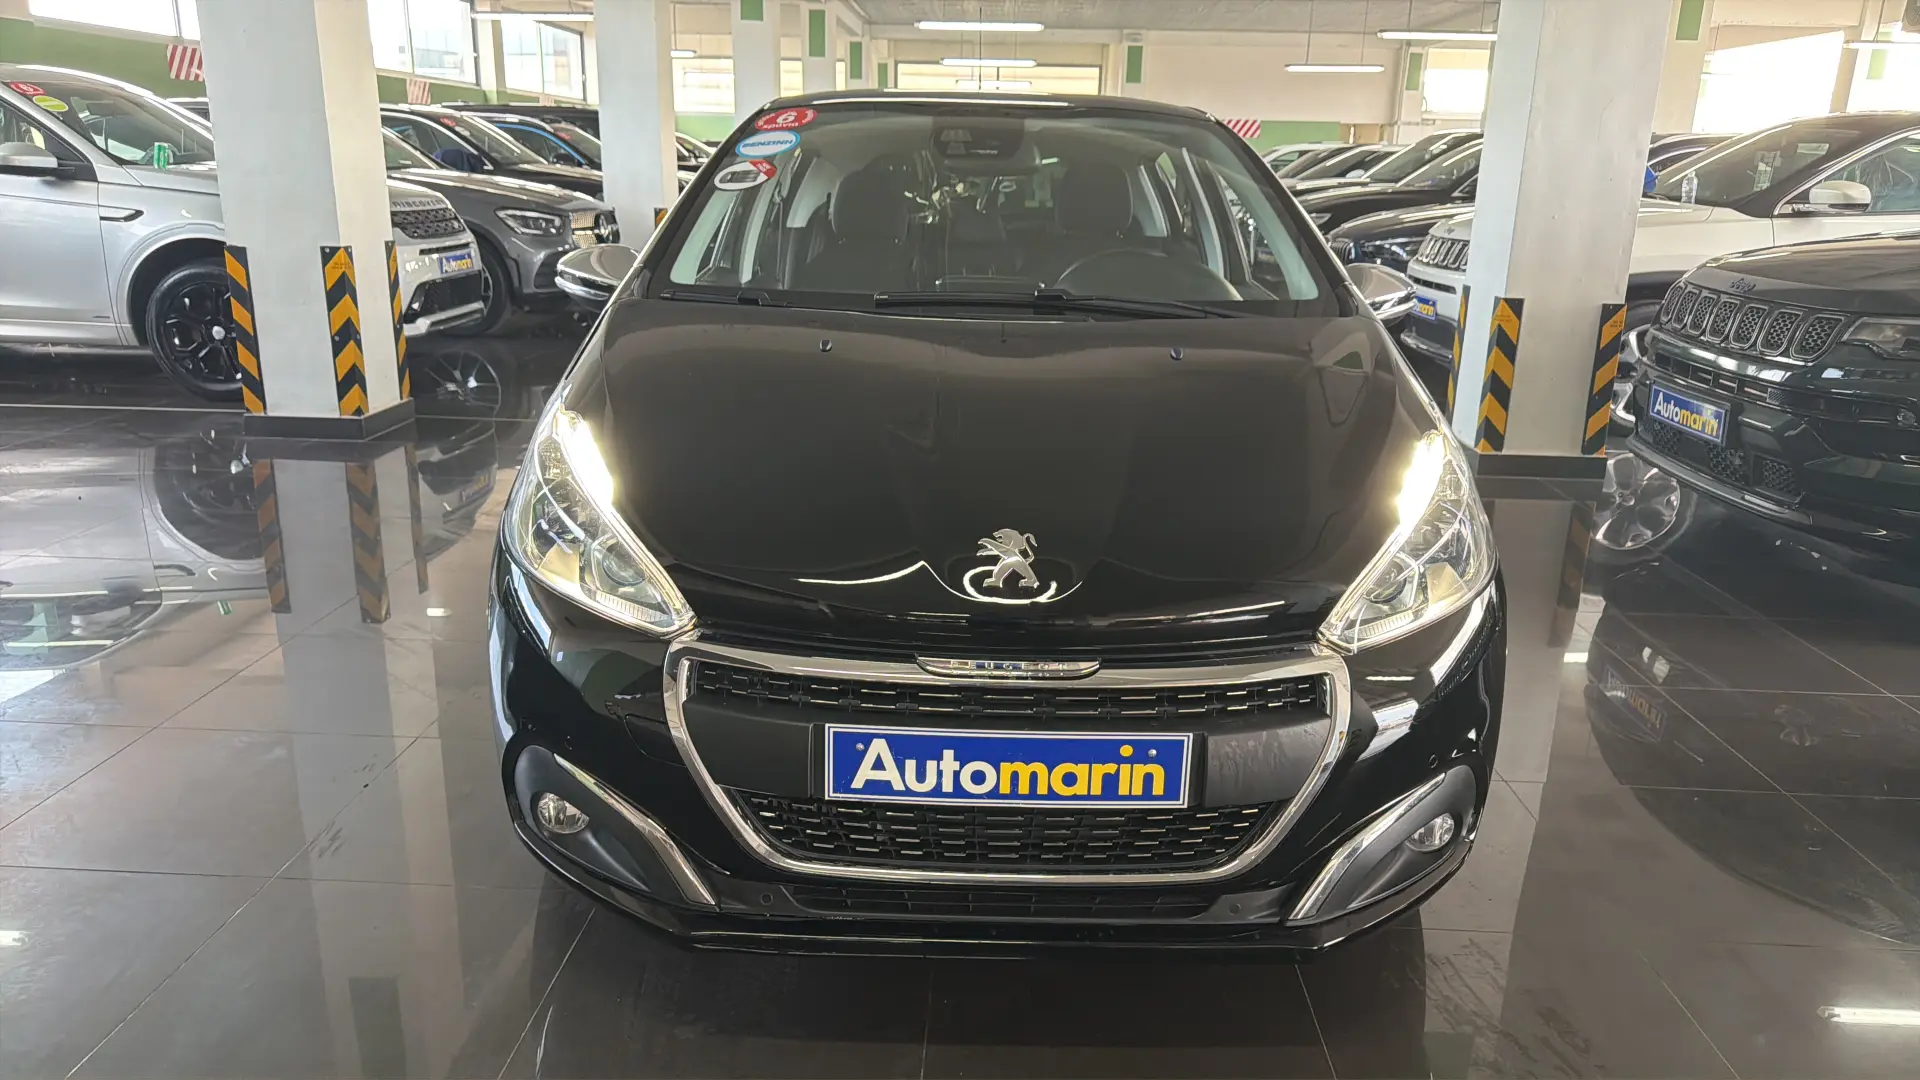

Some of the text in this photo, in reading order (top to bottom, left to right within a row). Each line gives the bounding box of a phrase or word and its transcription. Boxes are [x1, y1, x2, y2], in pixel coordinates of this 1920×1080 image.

[1653, 391, 1719, 437] Automarin
[950, 660, 1067, 671] PEUGEOT
[849, 737, 1166, 797] Automarin
